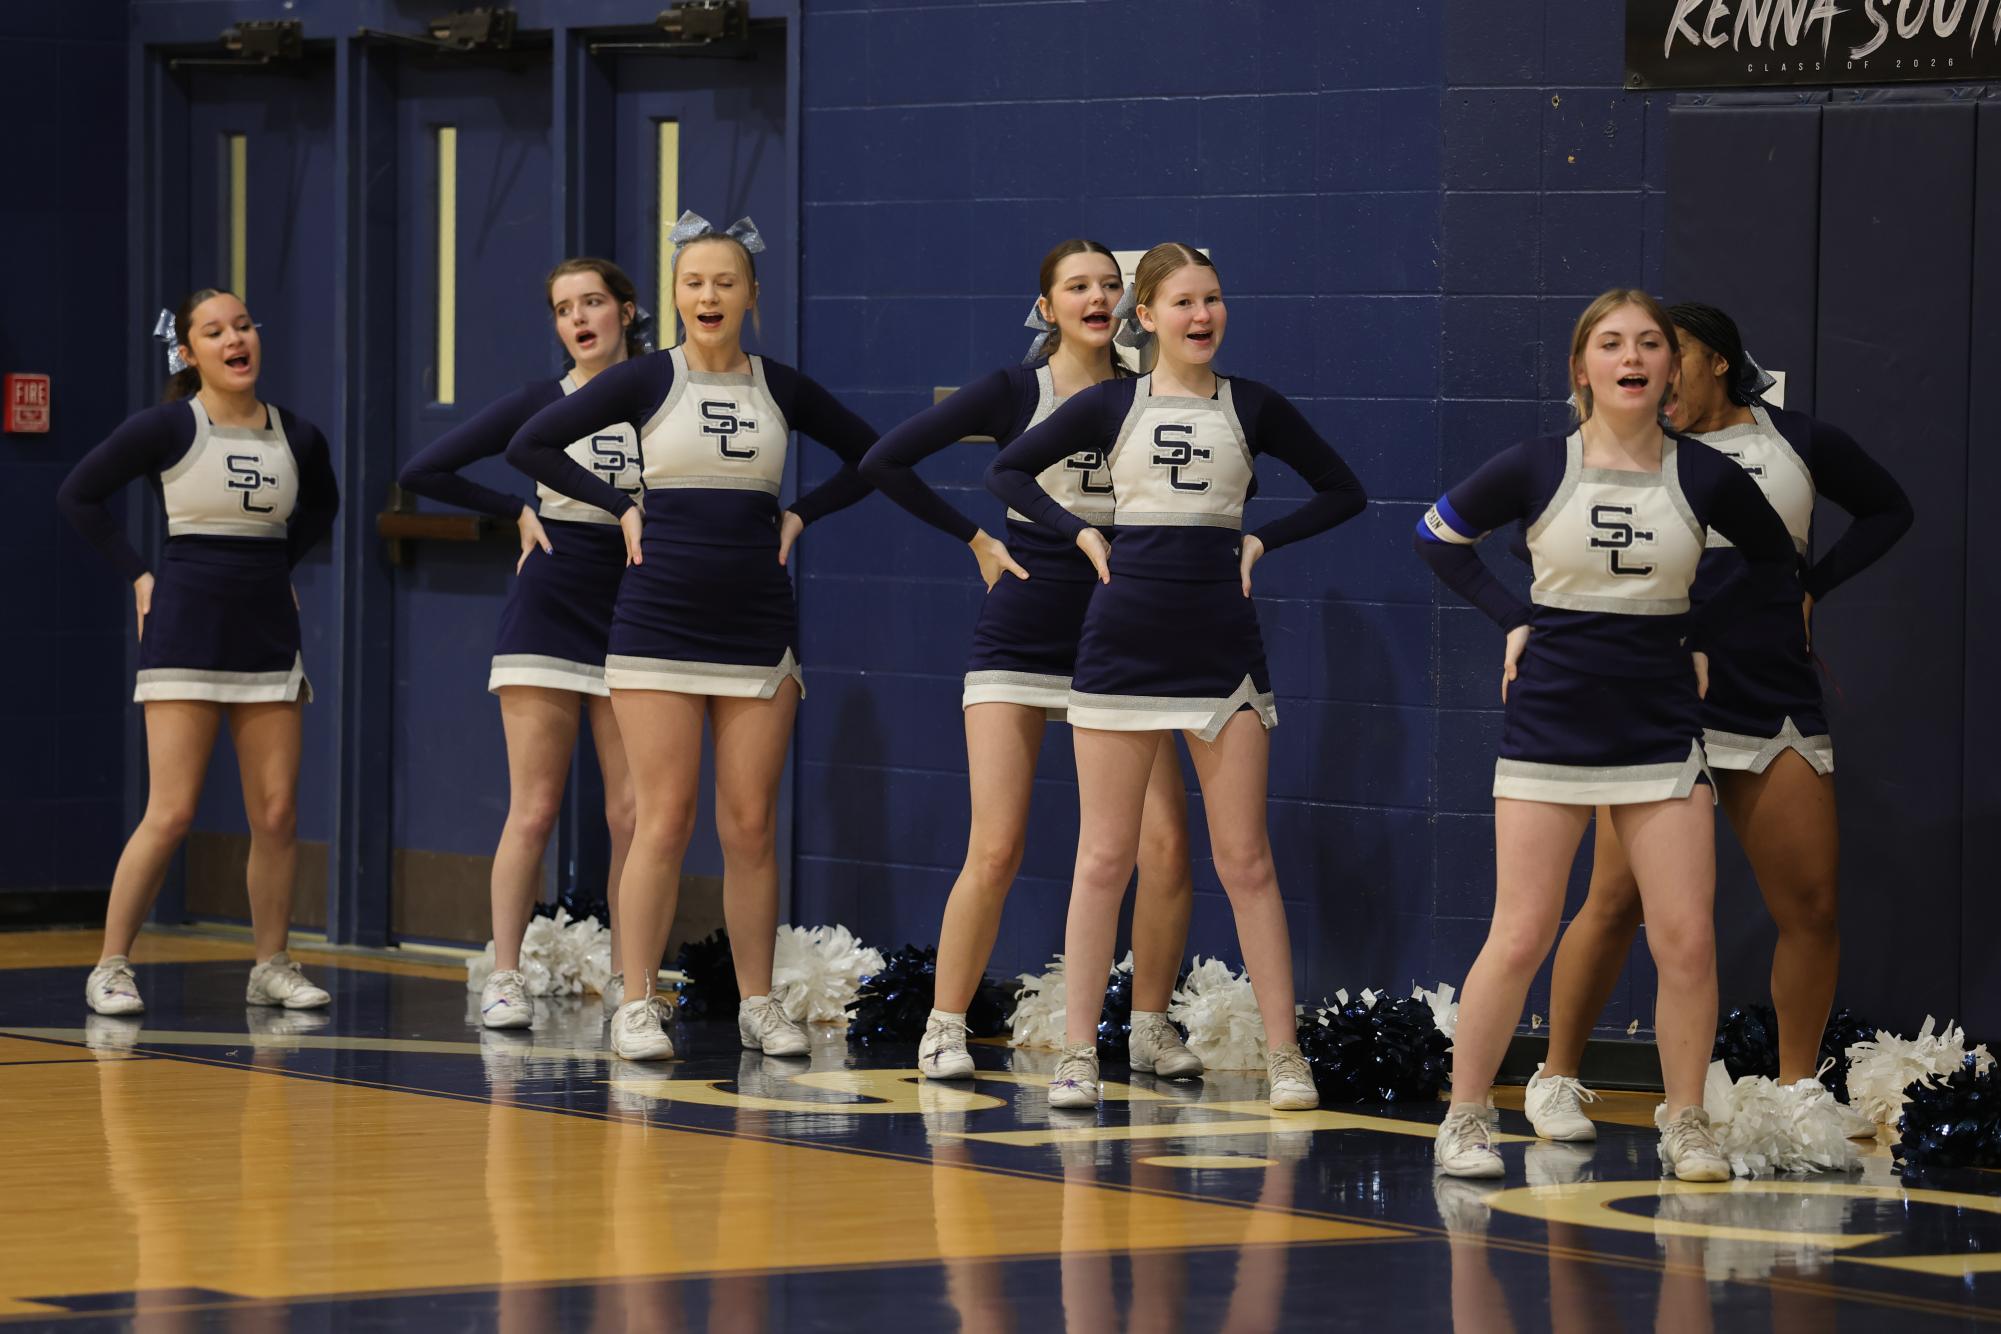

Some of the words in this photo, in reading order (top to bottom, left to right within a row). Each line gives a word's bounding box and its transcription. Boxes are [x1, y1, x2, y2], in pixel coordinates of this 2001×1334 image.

[1747, 62, 1821, 73] CLASS
[1847, 60, 1869, 70] OF
[1896, 58, 1954, 69] 2026
[15, 382, 47, 405] FIRE
[700, 400, 757, 460] SC
[1151, 423, 1212, 492] SC
[225, 453, 277, 515] SC
[1589, 503, 1655, 577] SC
